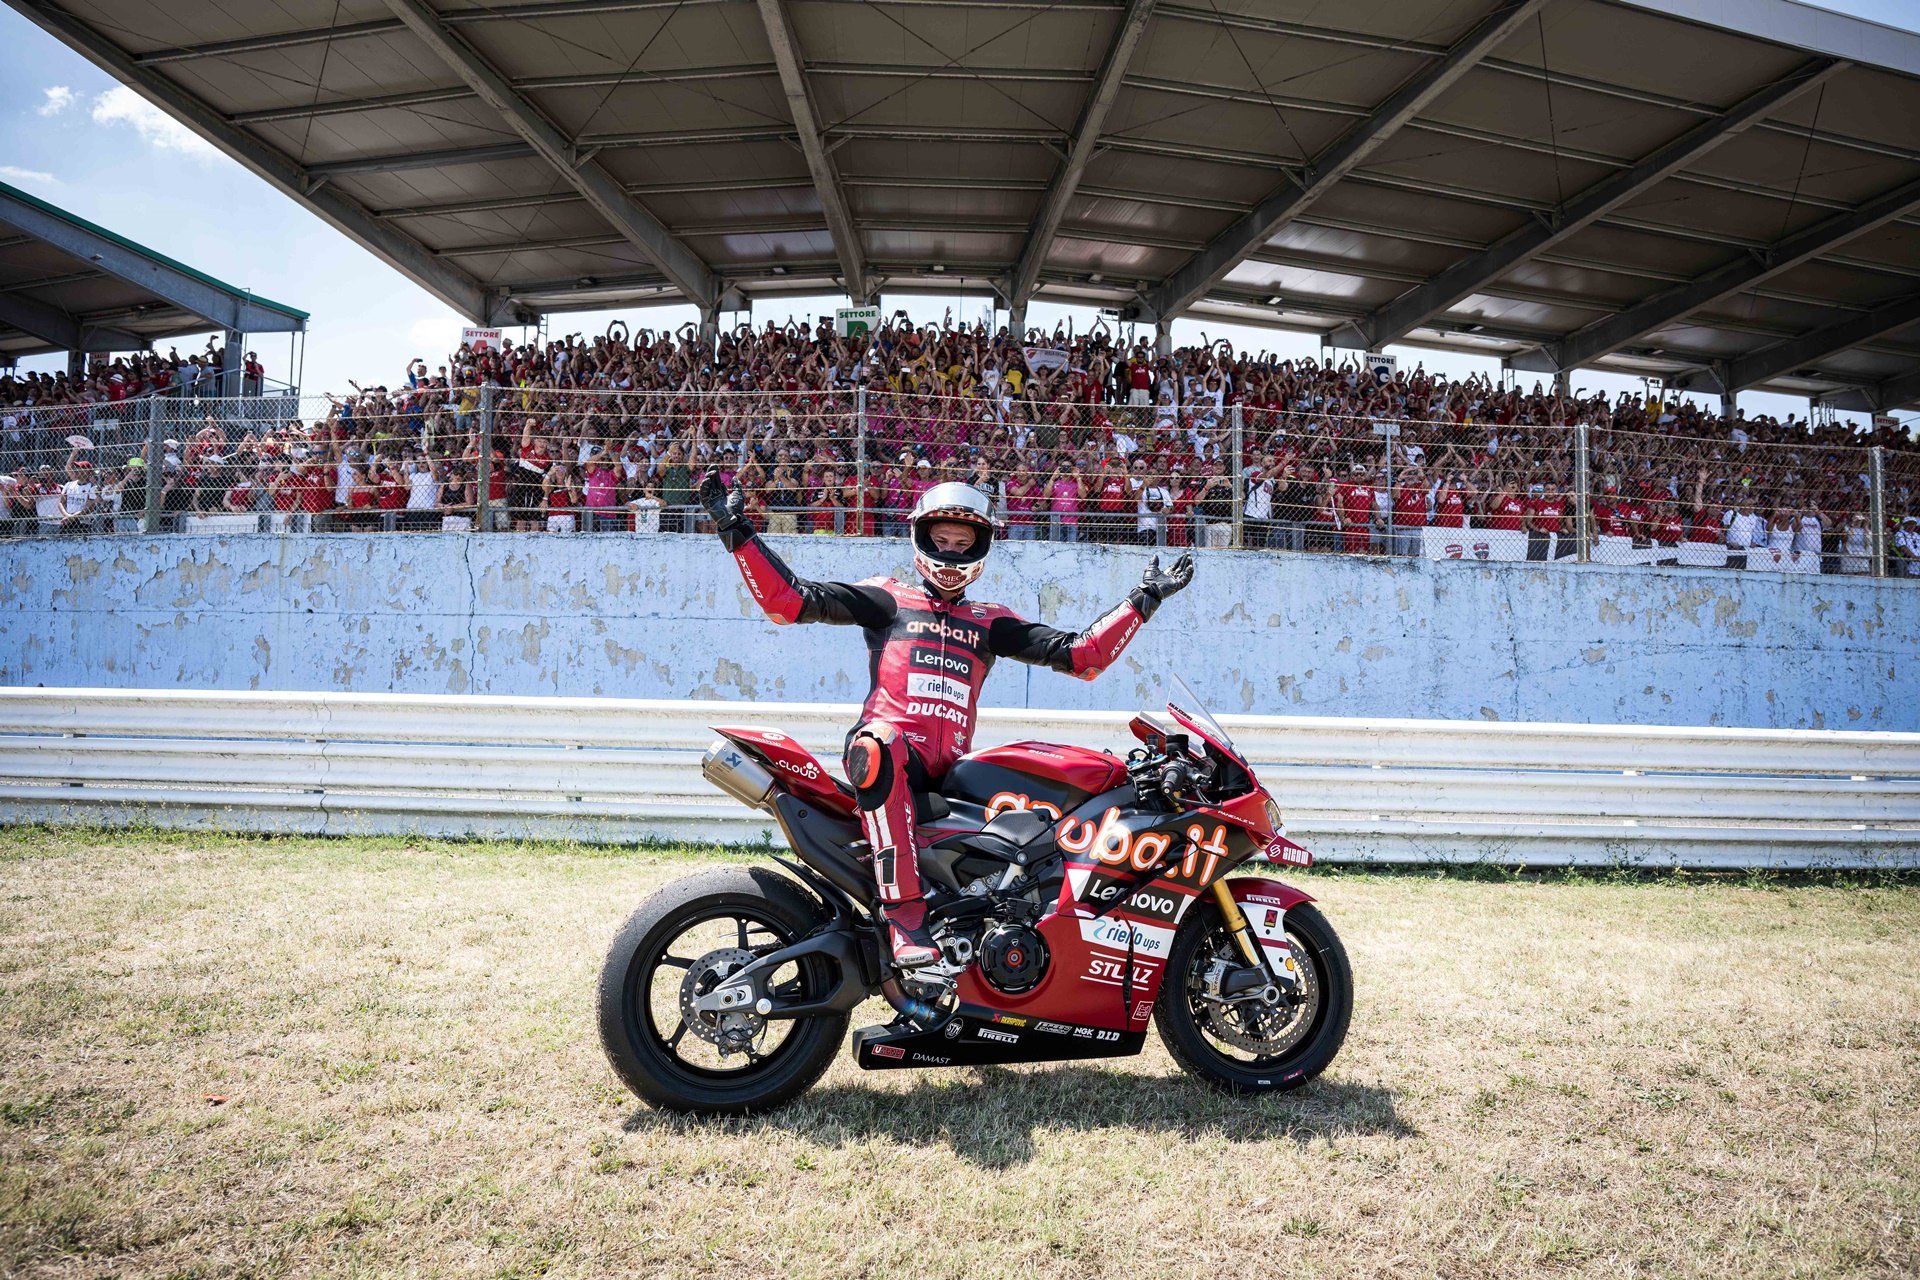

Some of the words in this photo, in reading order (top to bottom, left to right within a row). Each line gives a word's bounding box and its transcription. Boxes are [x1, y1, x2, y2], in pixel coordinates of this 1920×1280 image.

[1366, 356, 1394, 364] SETTORE
[736, 553, 764, 599] DAINESE
[906, 619, 980, 649] aruba.it
[1110, 616, 1139, 660] DAINESE
[915, 651, 969, 674] Lenovo
[928, 679, 953, 695] riello
[953, 690, 964, 700] ups
[906, 702, 968, 728] DUCATI
[1028, 750, 1065, 759] DUCATI
[1282, 846, 1309, 865] SICOM
[1089, 879, 1174, 914] Lenovo
[1246, 894, 1281, 905] PIRELLI
[1106, 924, 1143, 946] riello
[1143, 938, 1160, 951] ups
[1213, 968, 1221, 991] brembo
[946, 1023, 962, 1036] STM
[977, 1028, 1019, 1044] PIRELLI
[1075, 1027, 1094, 1036] NGK
[912, 1052, 951, 1065] DAMAST
